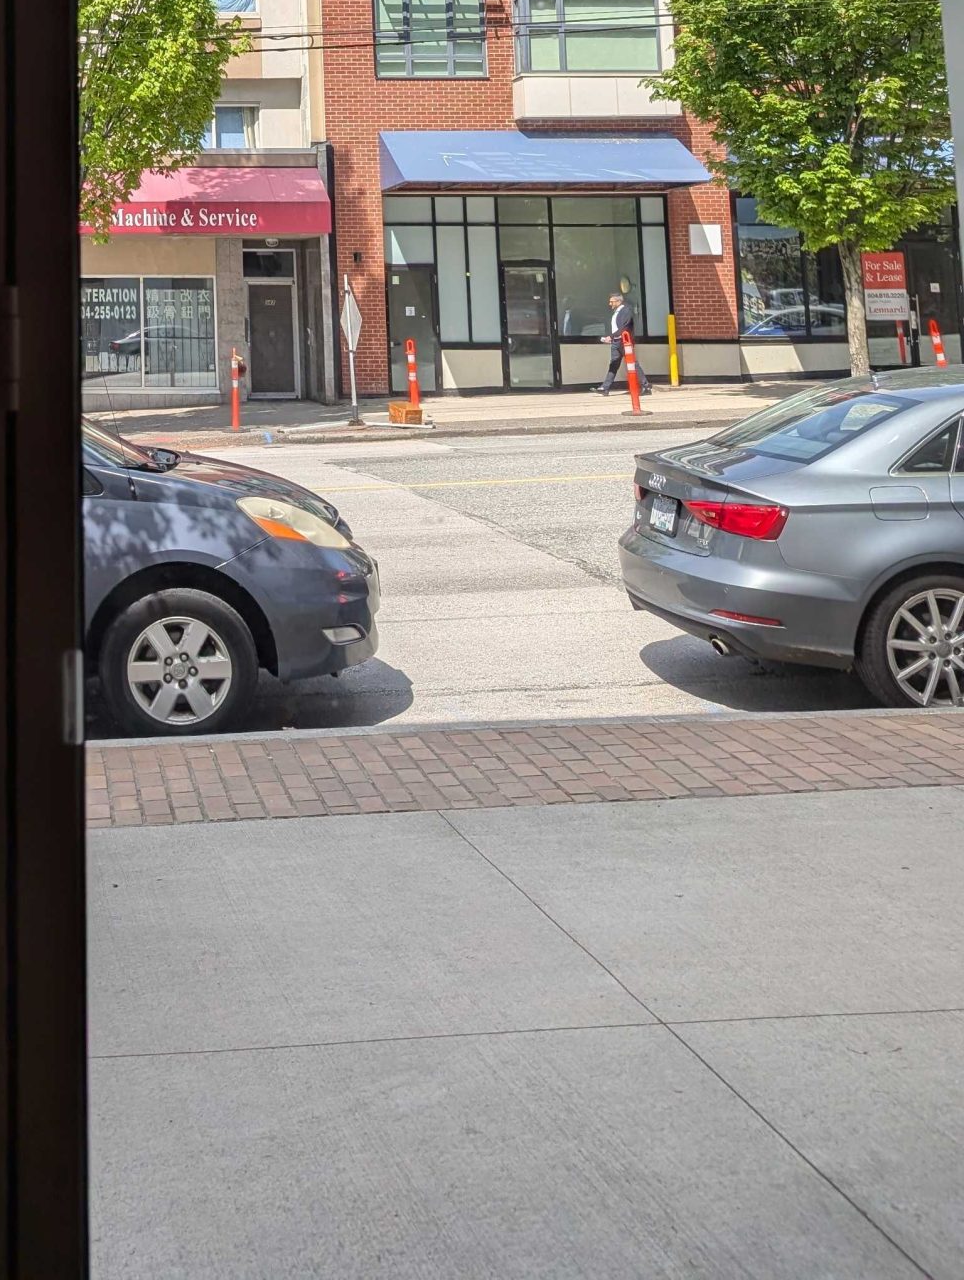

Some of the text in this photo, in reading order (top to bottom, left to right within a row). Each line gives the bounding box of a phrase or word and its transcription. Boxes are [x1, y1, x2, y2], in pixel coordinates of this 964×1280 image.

[180, 209, 194, 227] &
[198, 208, 258, 227] Service
[865, 261, 902, 270] For Sale
[866, 272, 903, 282] & Lease
[81, 288, 137, 303] TERATION
